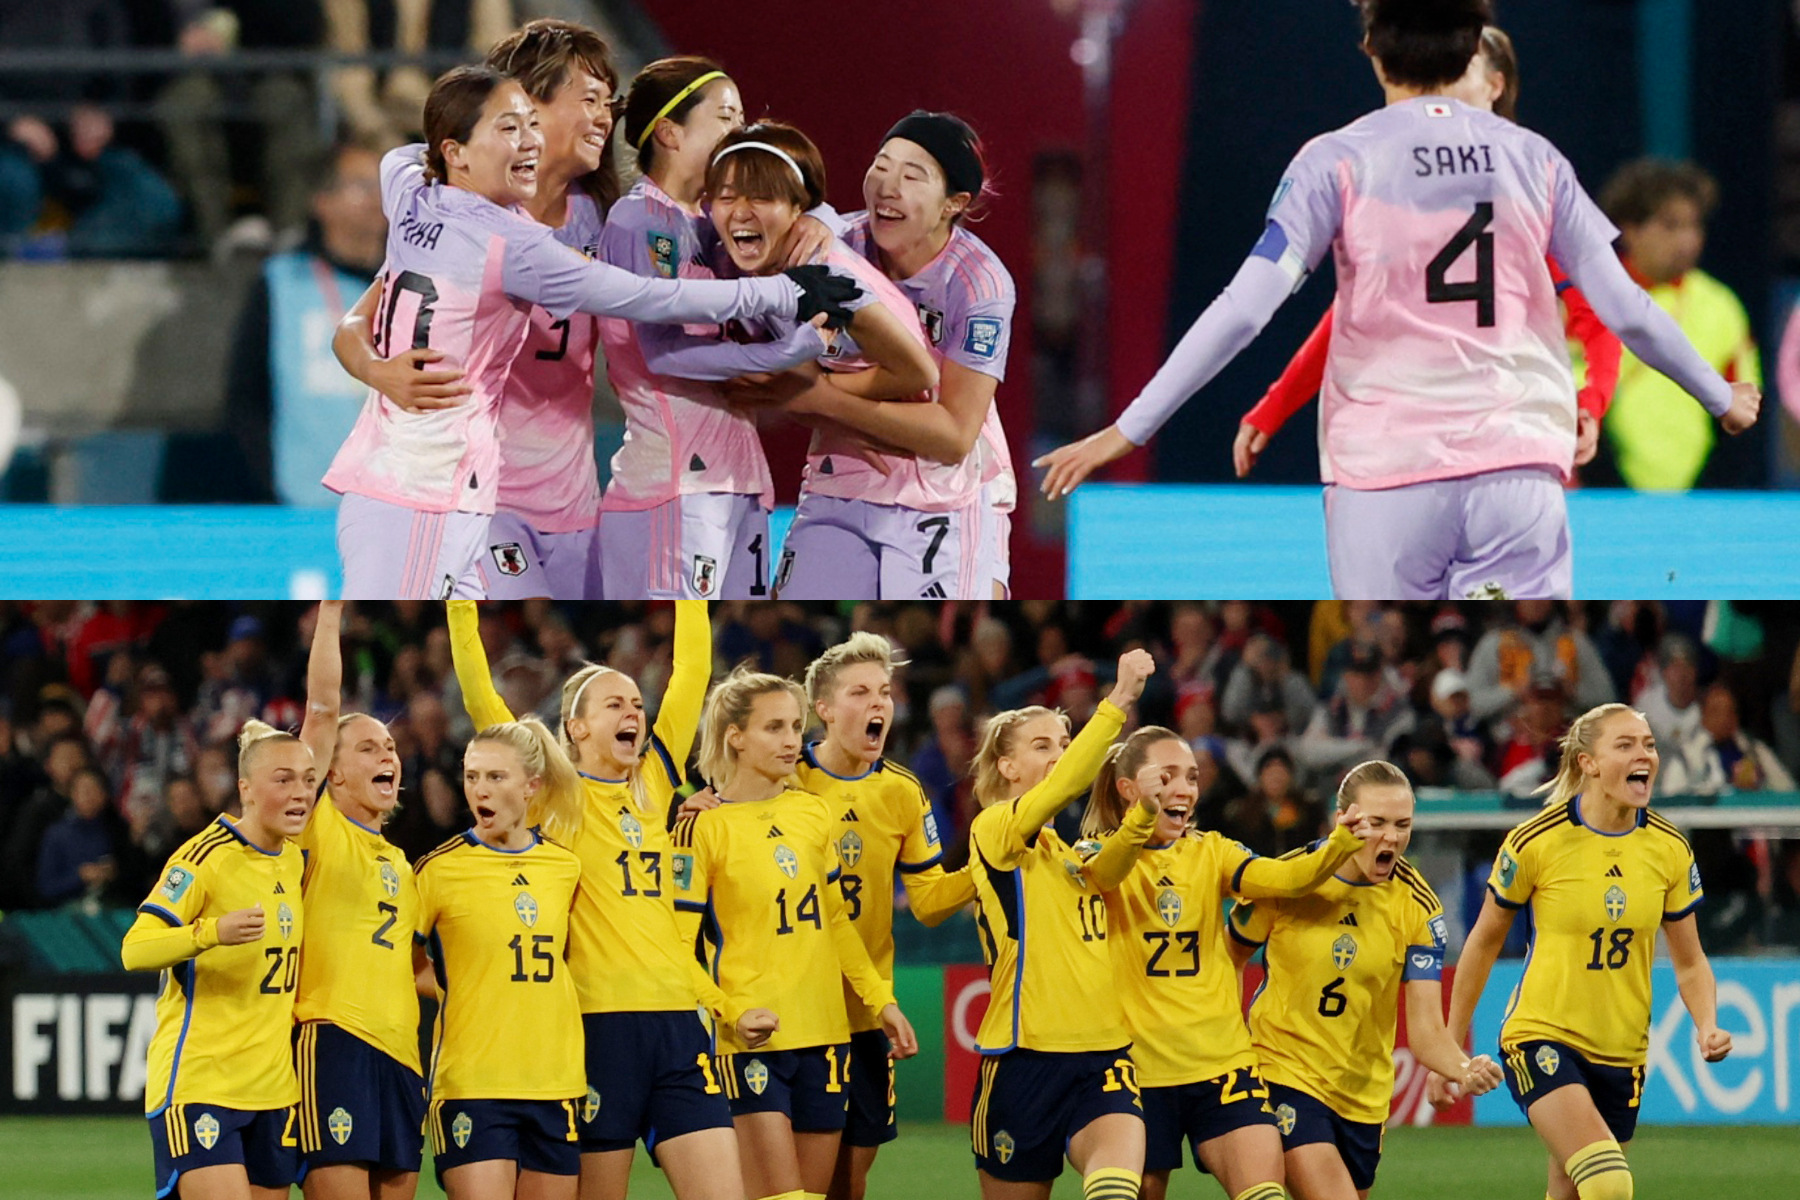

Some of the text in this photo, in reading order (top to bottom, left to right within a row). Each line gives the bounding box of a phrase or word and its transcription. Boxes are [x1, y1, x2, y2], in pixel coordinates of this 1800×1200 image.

[1413, 145, 1496, 177] SAKI
[1426, 202, 1496, 328] 4
[917, 516, 950, 574] 7
[615, 850, 661, 897] 13
[840, 874, 863, 921] 8
[372, 901, 398, 950] 2
[775, 883, 823, 935] 14
[1077, 894, 1106, 942] 10
[260, 946, 299, 994] 20
[508, 934, 555, 983] 15
[1143, 931, 1201, 977] 23
[1586, 927, 1635, 970] 18
[1317, 977, 1348, 1018] 6
